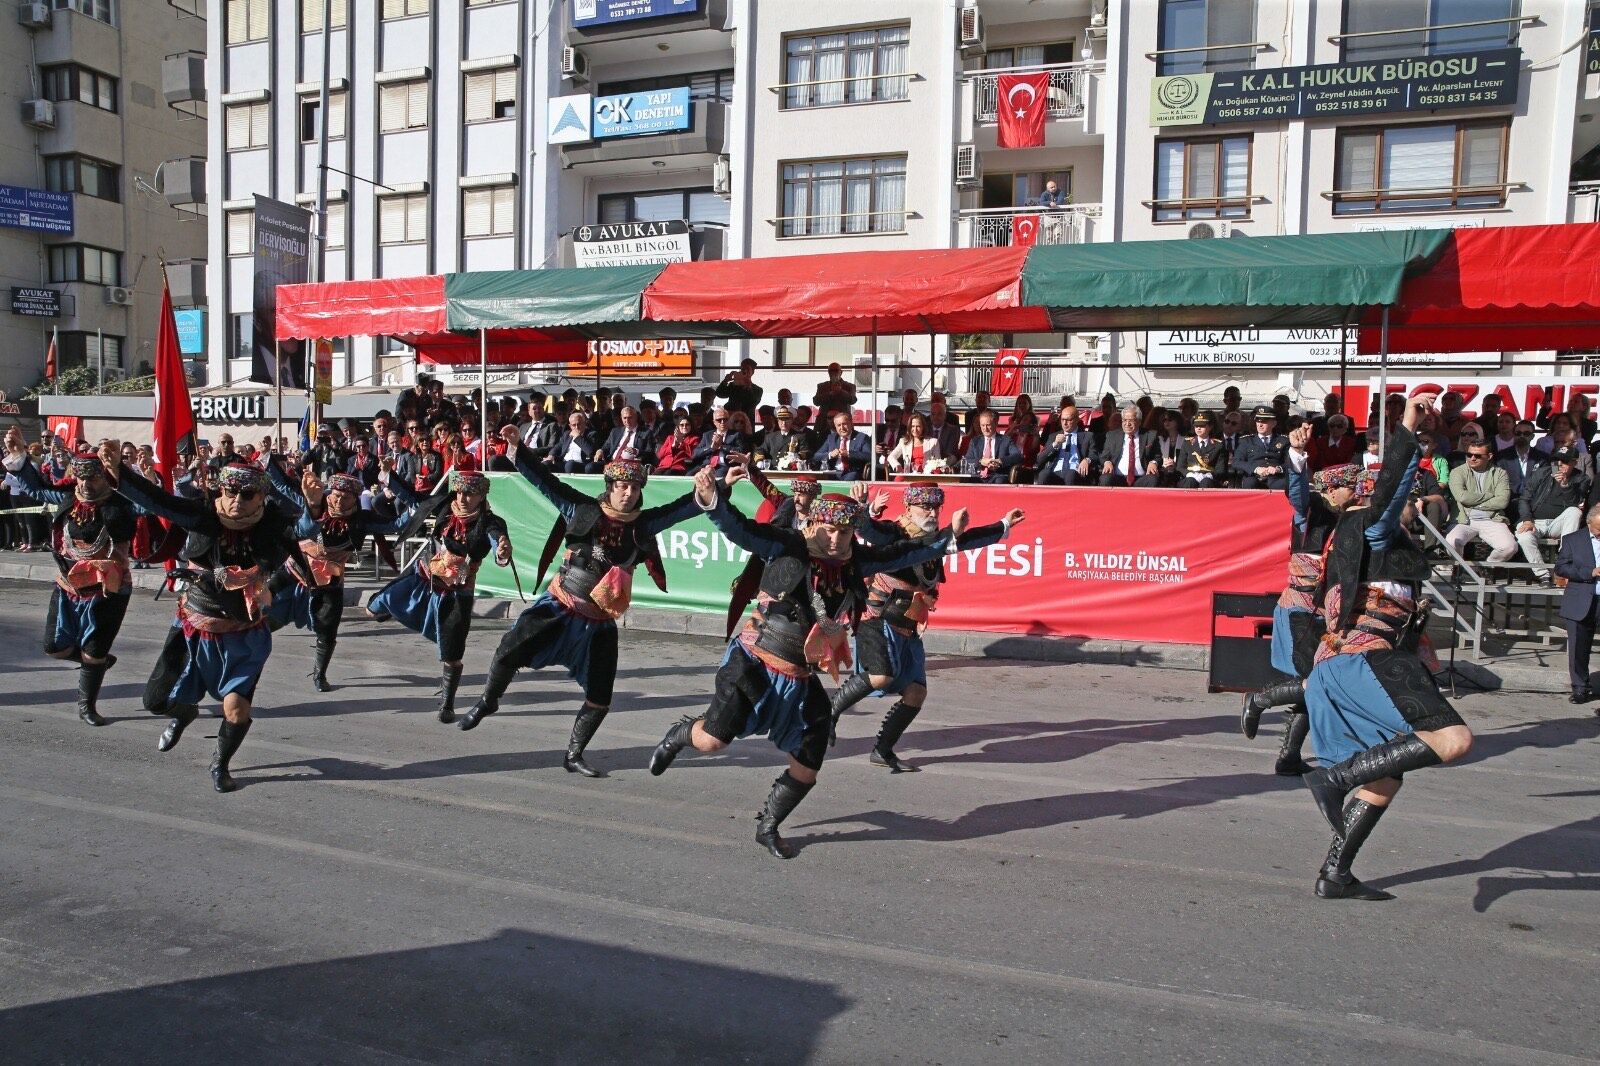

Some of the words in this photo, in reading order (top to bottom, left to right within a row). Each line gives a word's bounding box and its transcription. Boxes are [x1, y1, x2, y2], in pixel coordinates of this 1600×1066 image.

[1241, 72, 1295, 92] K.A.L
[1300, 65, 1377, 88] HUKUK
[1382, 57, 1478, 81] BÜROSU
[1306, 92, 1319, 100] Av.
[1320, 89, 1346, 100] Zeynel
[1347, 88, 1373, 97] Abidin
[1417, 85, 1430, 93] Av.
[1432, 82, 1472, 93] Alparslan
[647, 92, 673, 106] YAPI
[1225, 97, 1259, 106] Doğukan
[1419, 95, 1445, 105] 0530
[1447, 93, 1466, 103] 831
[1468, 92, 1482, 101] 54
[1484, 90, 1498, 100] 35
[595, 96, 633, 124] OK
[1315, 102, 1339, 111] 0532
[1341, 100, 1359, 109] 518
[1361, 99, 1374, 108] 39
[1375, 98, 1388, 107] 61
[1218, 109, 1241, 118] 0506
[1243, 107, 1260, 116] 587
[1262, 106, 1274, 115] 40
[1275, 105, 1287, 114] 41
[599, 221, 670, 240] AVUKAT
[259, 230, 306, 257] DERVİŞOĞLU
[635, 239, 682, 253] BİNGÖL
[19, 289, 54, 298] AVUKAT
[1286, 329, 1339, 340] AVUKAT
[663, 340, 691, 354] DIA
[1309, 347, 1331, 356] 0232
[1174, 353, 1210, 363] HUKUK
[1213, 351, 1256, 363] BÜROSU
[453, 374, 480, 382] SEZER
[484, 374, 517, 382] YYILDIZ
[1065, 552, 1080, 568] B.
[1083, 553, 1133, 570] YILDIZ
[1136, 551, 1188, 571] ÜNSAL
[1067, 570, 1109, 582] KARŞIYAKA
[1111, 571, 1147, 582] BELEDİYE
[1149, 574, 1184, 585] BAŞKANI
